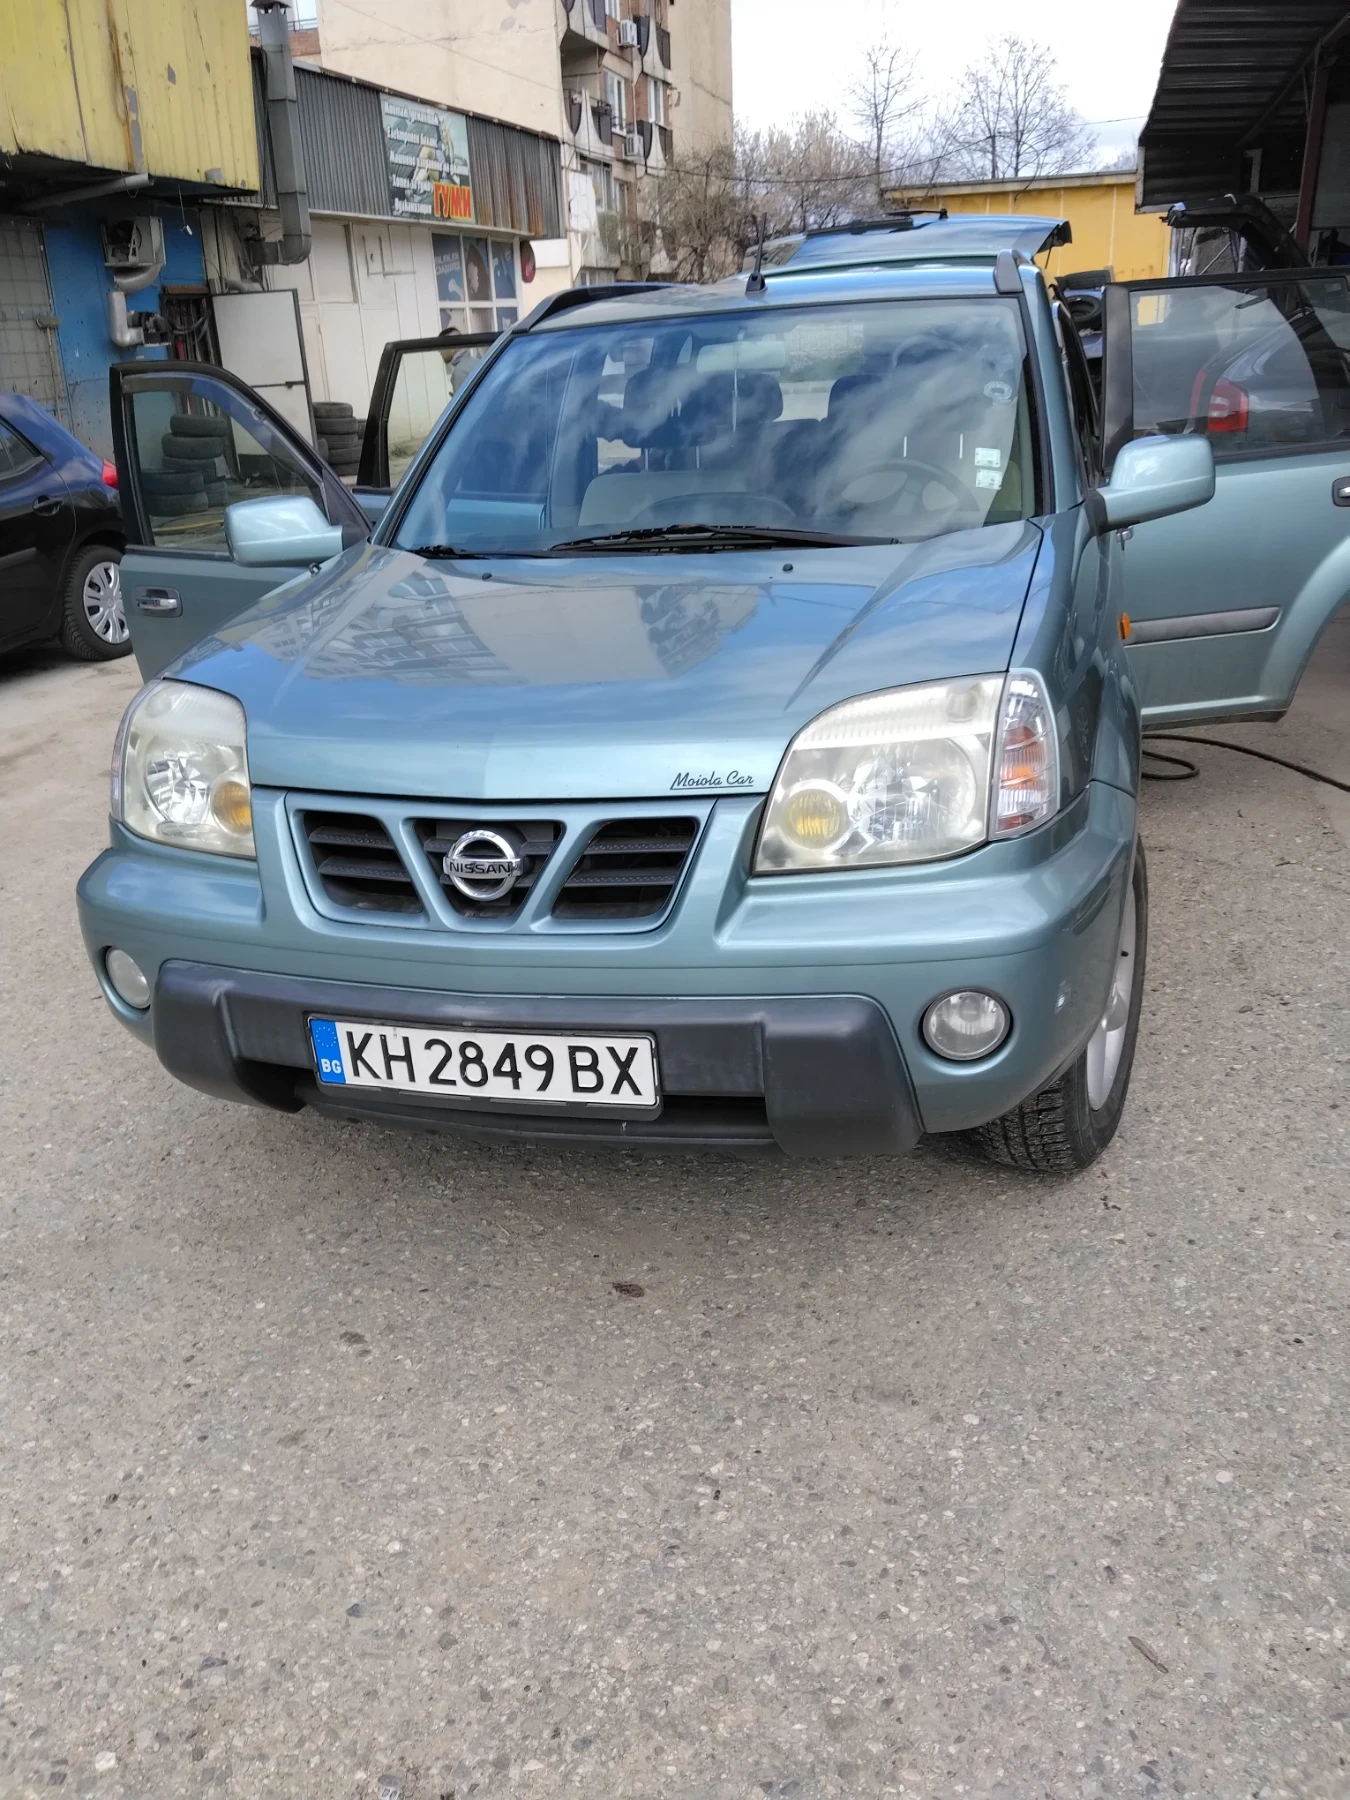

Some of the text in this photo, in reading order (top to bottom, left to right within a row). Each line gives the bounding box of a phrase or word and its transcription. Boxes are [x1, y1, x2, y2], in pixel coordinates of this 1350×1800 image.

[433, 181, 472, 218] ГУМИ
[670, 770, 754, 790] Moiola Car
[449, 861, 511, 875] NISSAN
[321, 1058, 342, 1074] BG
